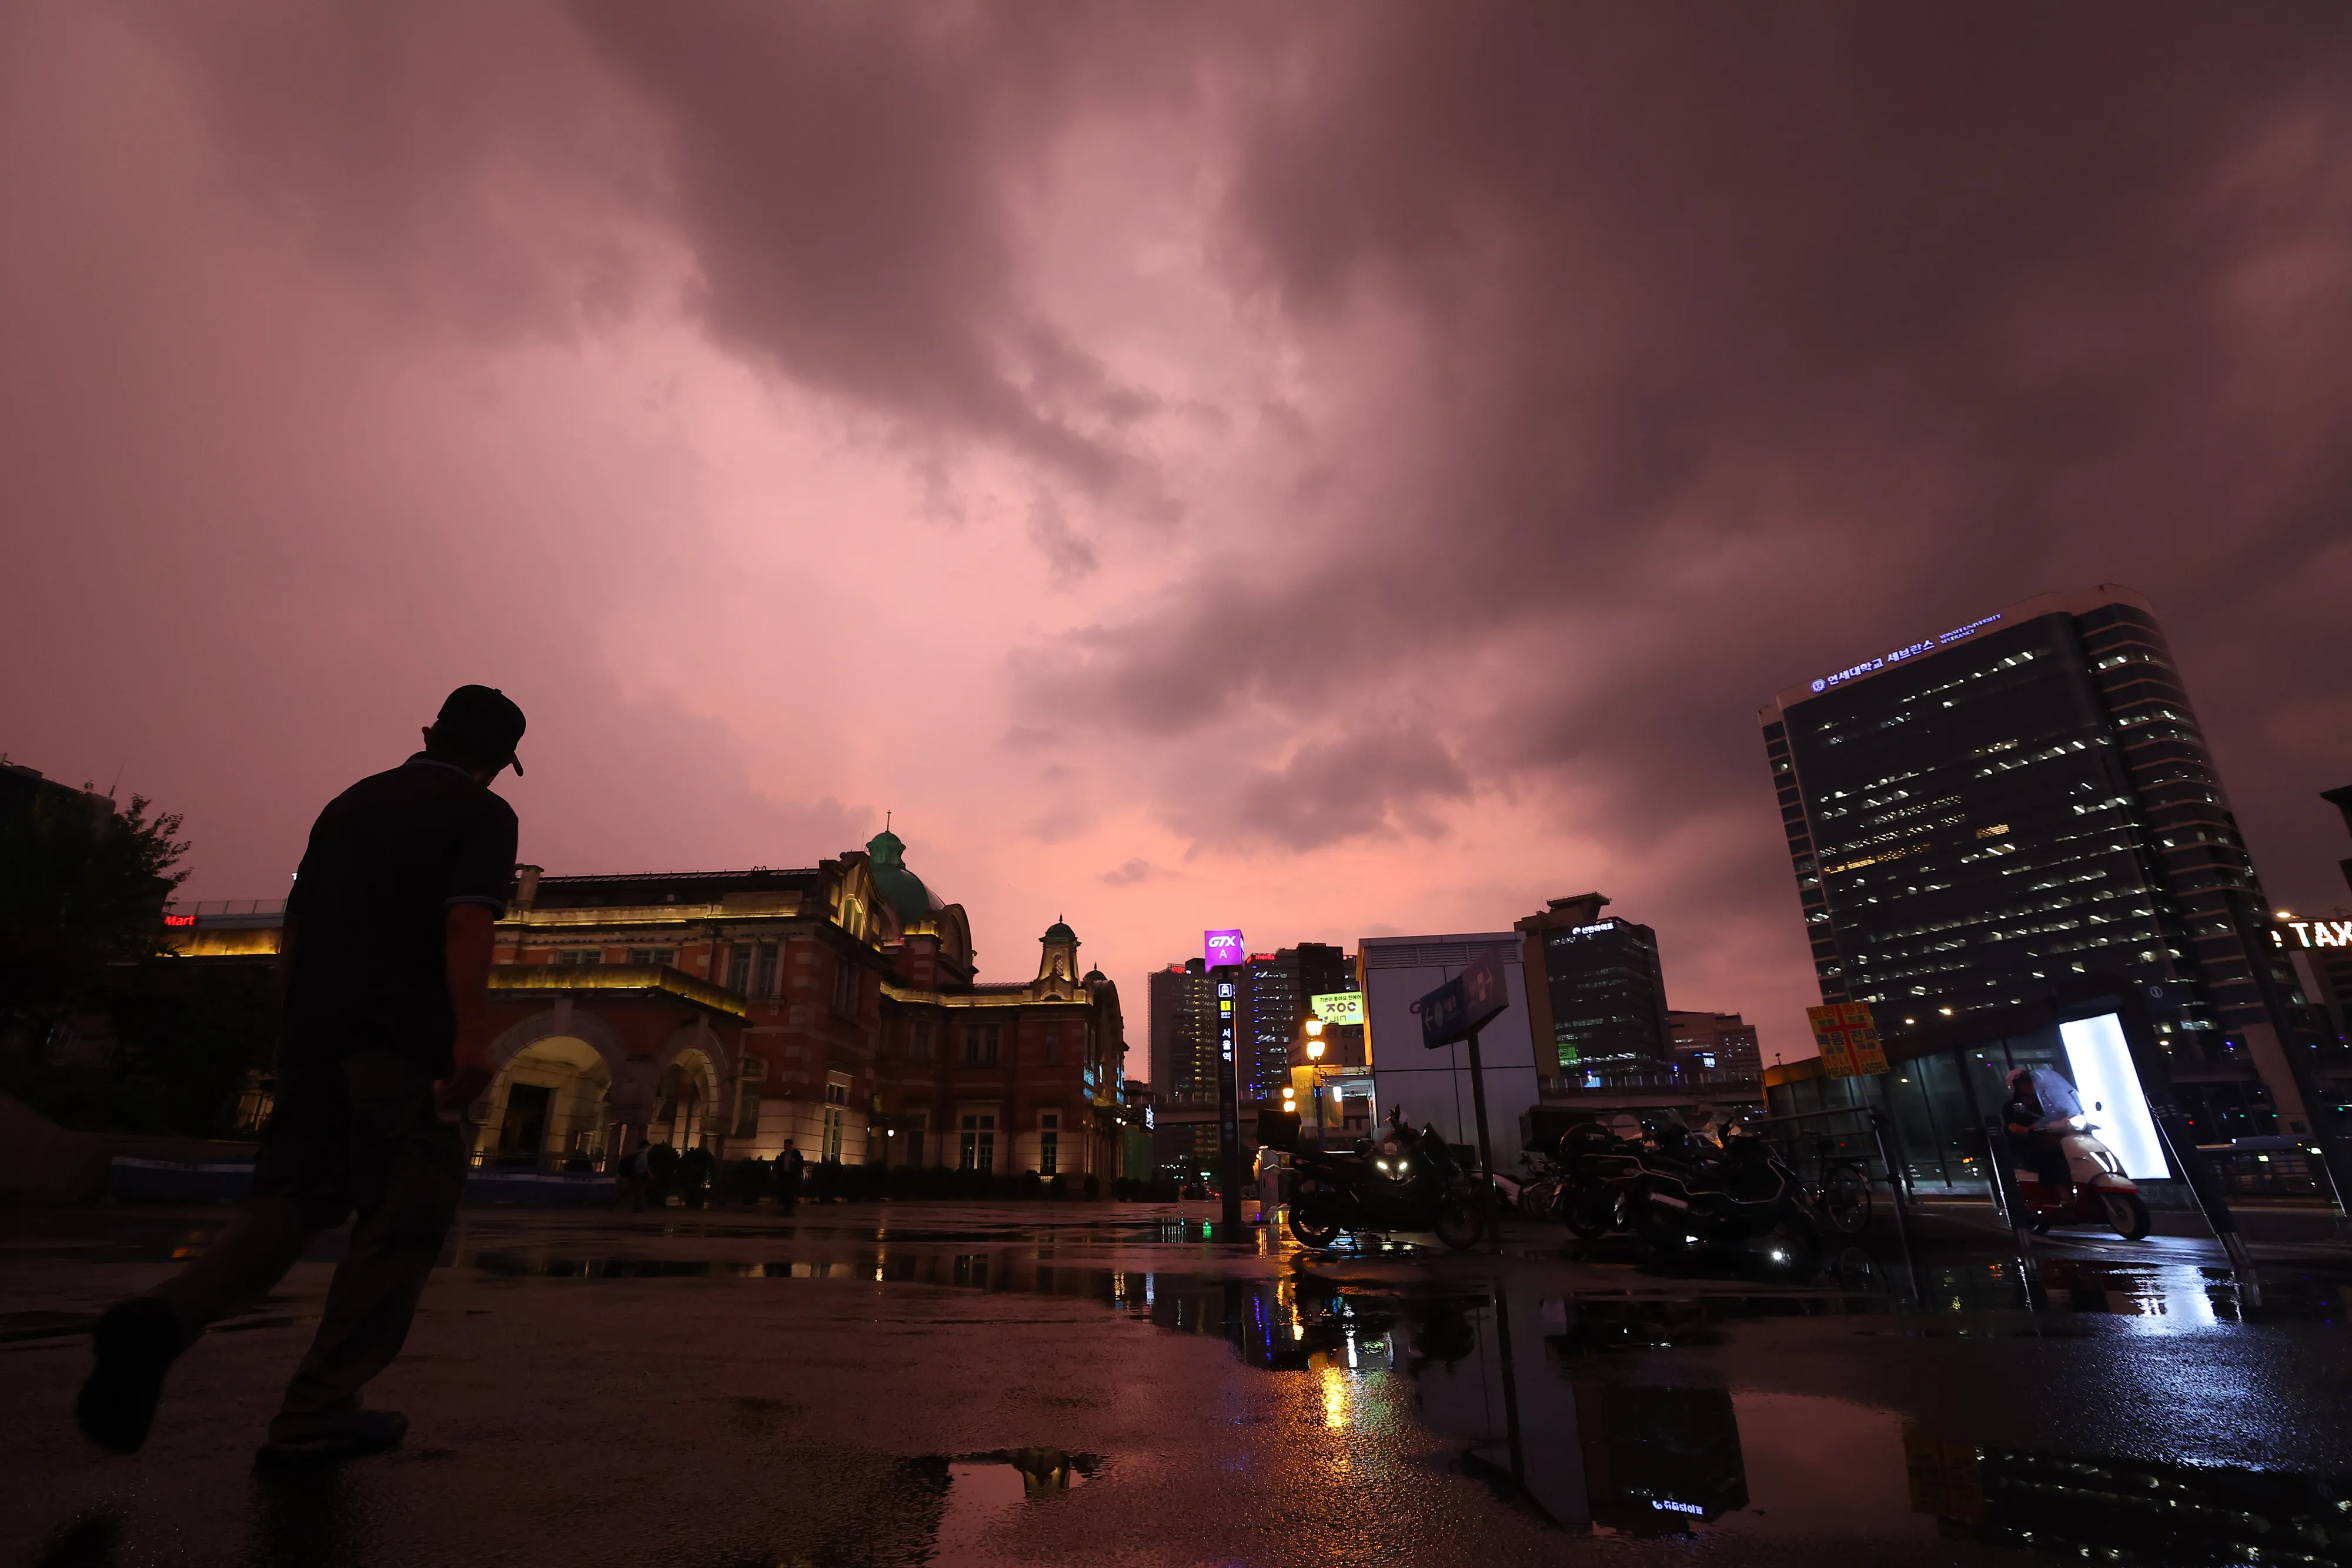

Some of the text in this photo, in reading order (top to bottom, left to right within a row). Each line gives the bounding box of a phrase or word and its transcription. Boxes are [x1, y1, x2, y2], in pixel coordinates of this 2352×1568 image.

[1827, 639, 1935, 686] 연세대학교 세브란스
[165, 915, 196, 926] Mart
[1581, 922, 1614, 934] 신한라이프
[1208, 935, 1237, 948] GTX
[1218, 948, 1228, 959] A
[1817, 1028, 1877, 1045] 복음 전파
[1222, 1028, 1231, 1062] 서울역
[1823, 1054, 1850, 1066] HOLY
[1826, 1062, 1889, 1078] PREACH GOSPEL
